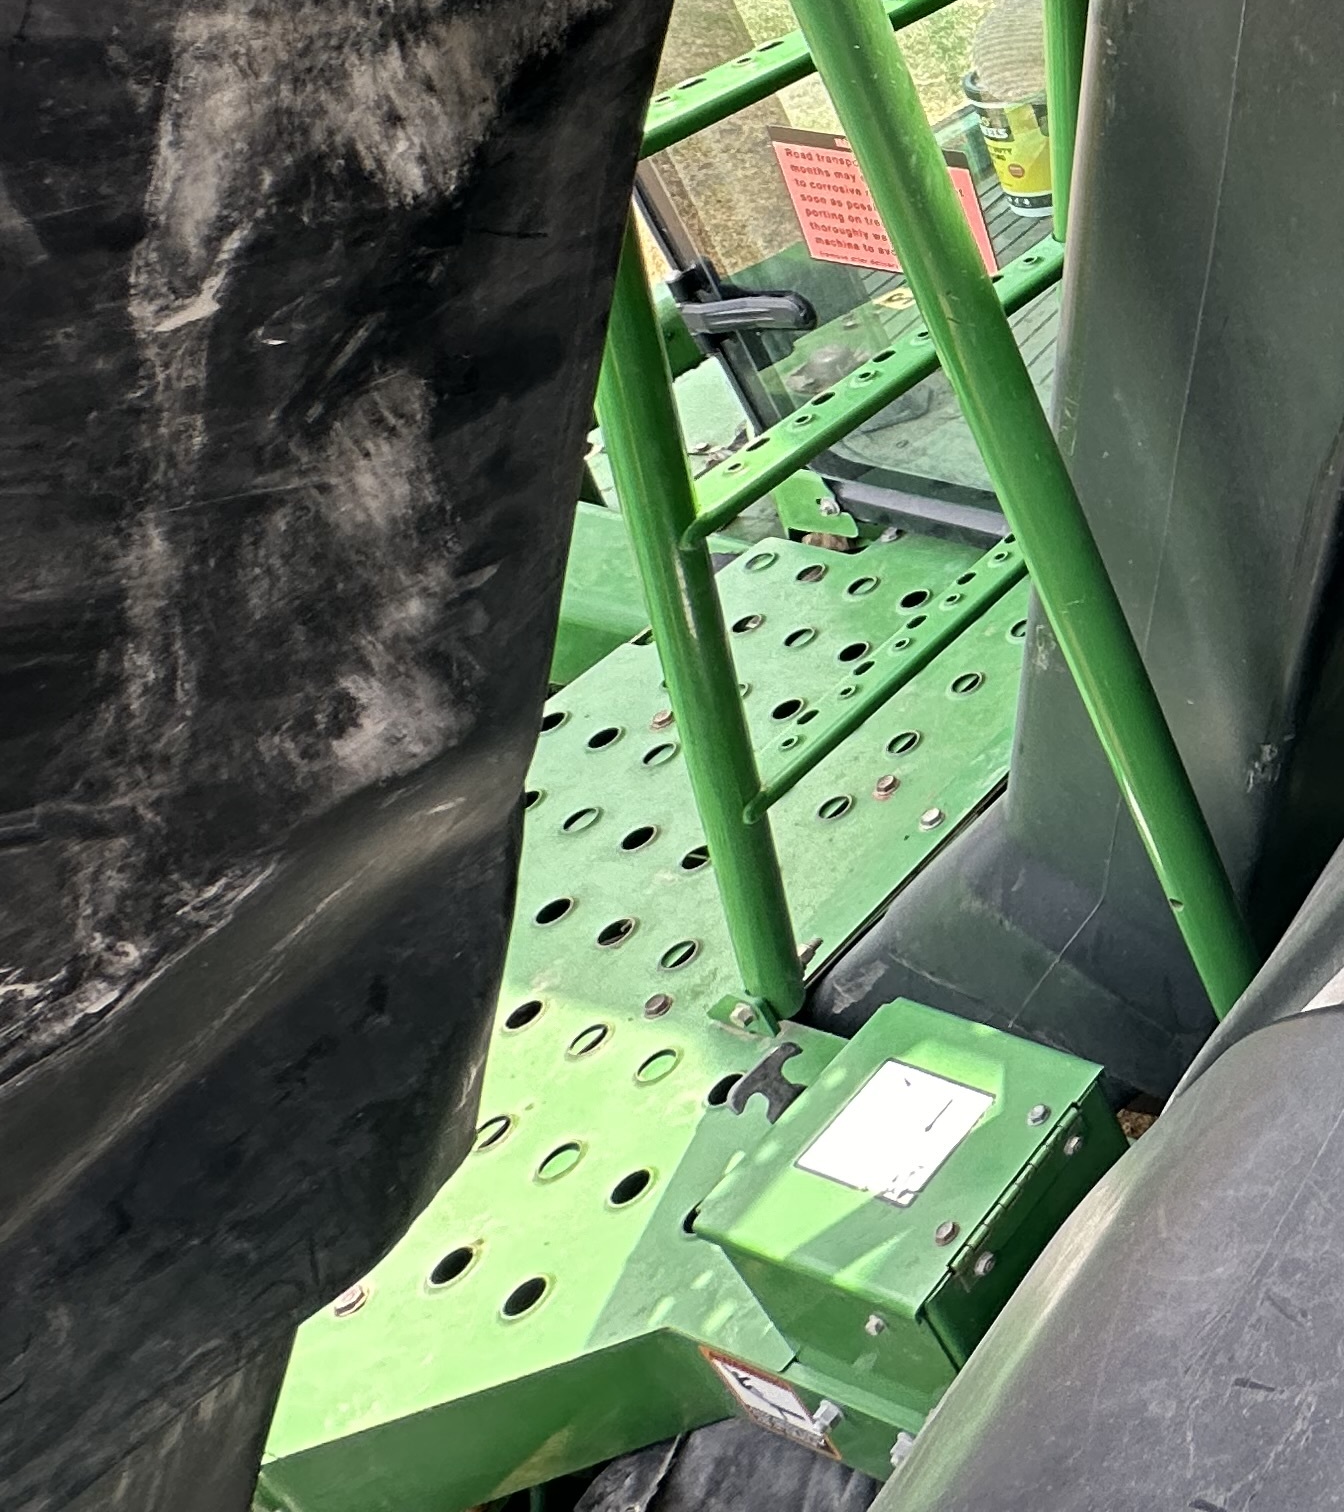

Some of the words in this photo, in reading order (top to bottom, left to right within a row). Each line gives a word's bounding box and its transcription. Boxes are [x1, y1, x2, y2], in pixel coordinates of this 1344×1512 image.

[784, 147, 813, 162] Road
[789, 164, 831, 178] months
[834, 169, 857, 183] may
[794, 177, 807, 188] to
[809, 180, 862, 196] corrosive
[800, 193, 827, 205] soon
[830, 198, 843, 208] as
[805, 208, 845, 224] porting
[847, 215, 863, 224] on
[808, 221, 869, 240] thoroughly
[814, 236, 861, 251] machine
[862, 243, 875, 254] to
